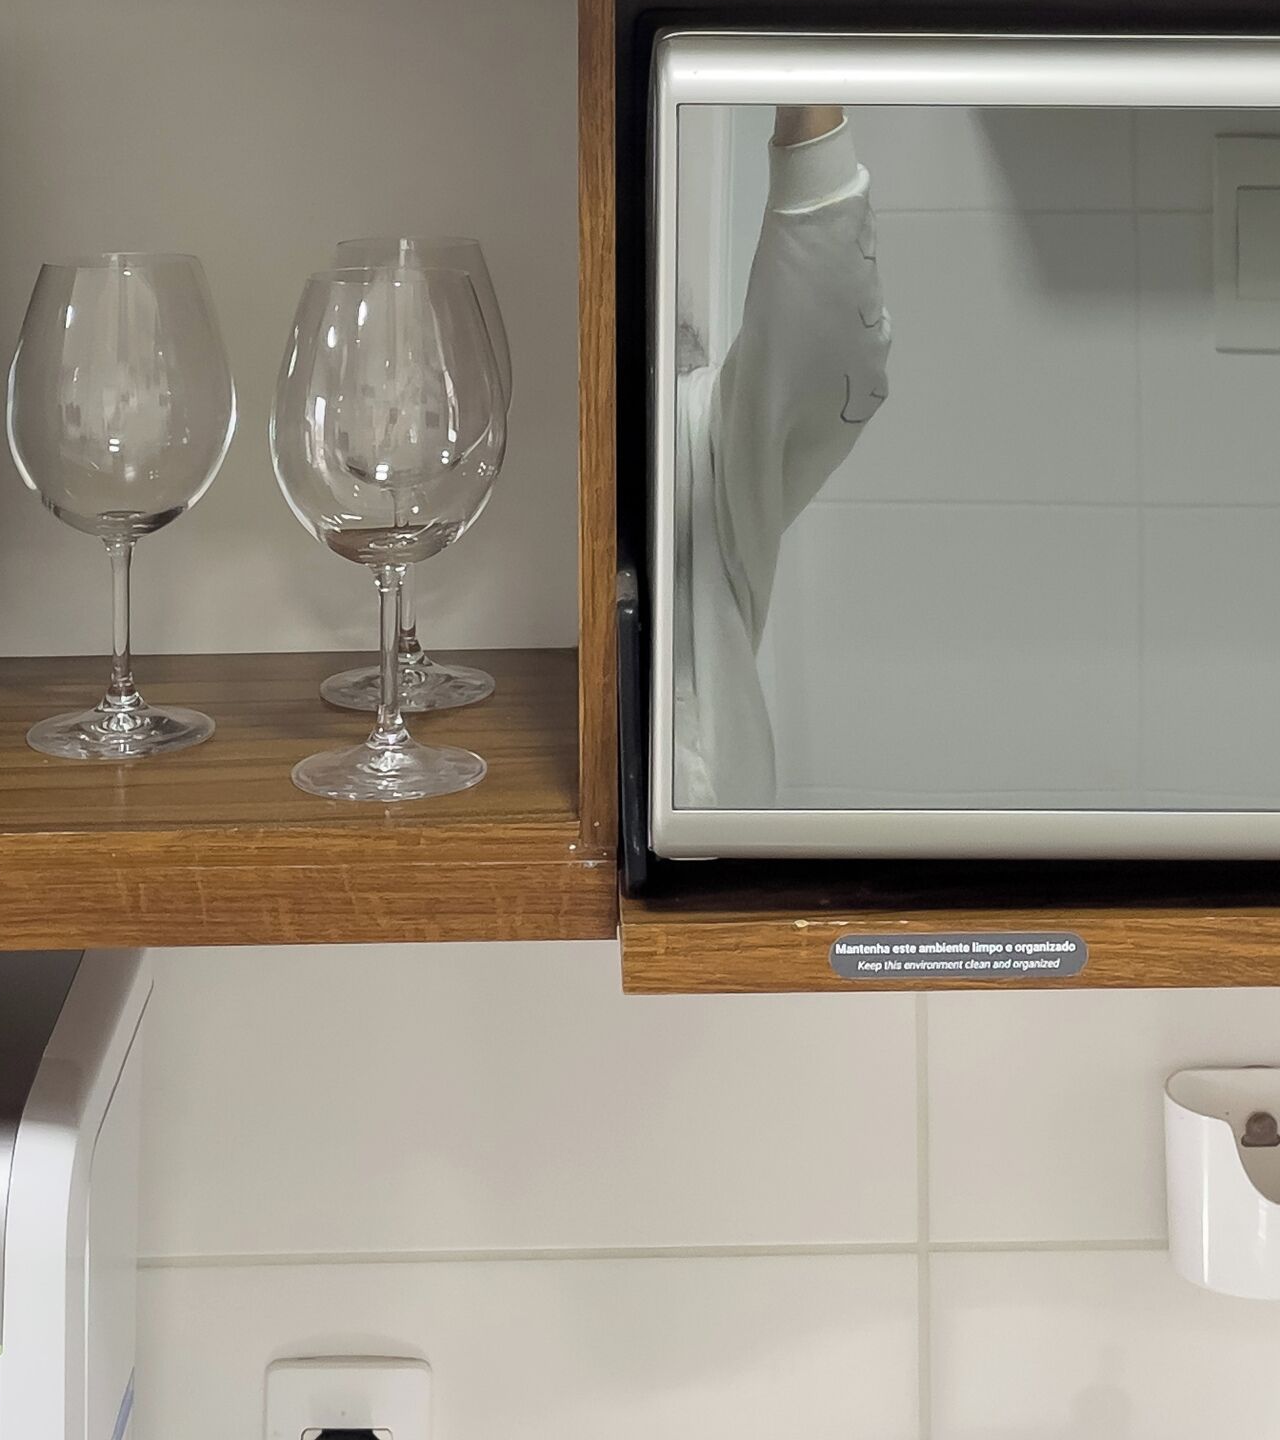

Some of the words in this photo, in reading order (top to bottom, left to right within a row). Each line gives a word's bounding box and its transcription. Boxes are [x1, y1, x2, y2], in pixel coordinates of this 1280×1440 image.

[835, 943, 890, 955] Mantenha
[892, 944, 917, 955] este
[918, 942, 970, 954] ambiente
[971, 941, 1003, 956] limpo
[1004, 943, 1013, 953] e
[1014, 940, 1076, 955] organizado
[857, 960, 882, 972] Keep
[884, 960, 902, 971] this
[903, 959, 963, 971] environment
[964, 959, 991, 970] clean
[992, 958, 1012, 970] and
[1012, 958, 1061, 972] organized
